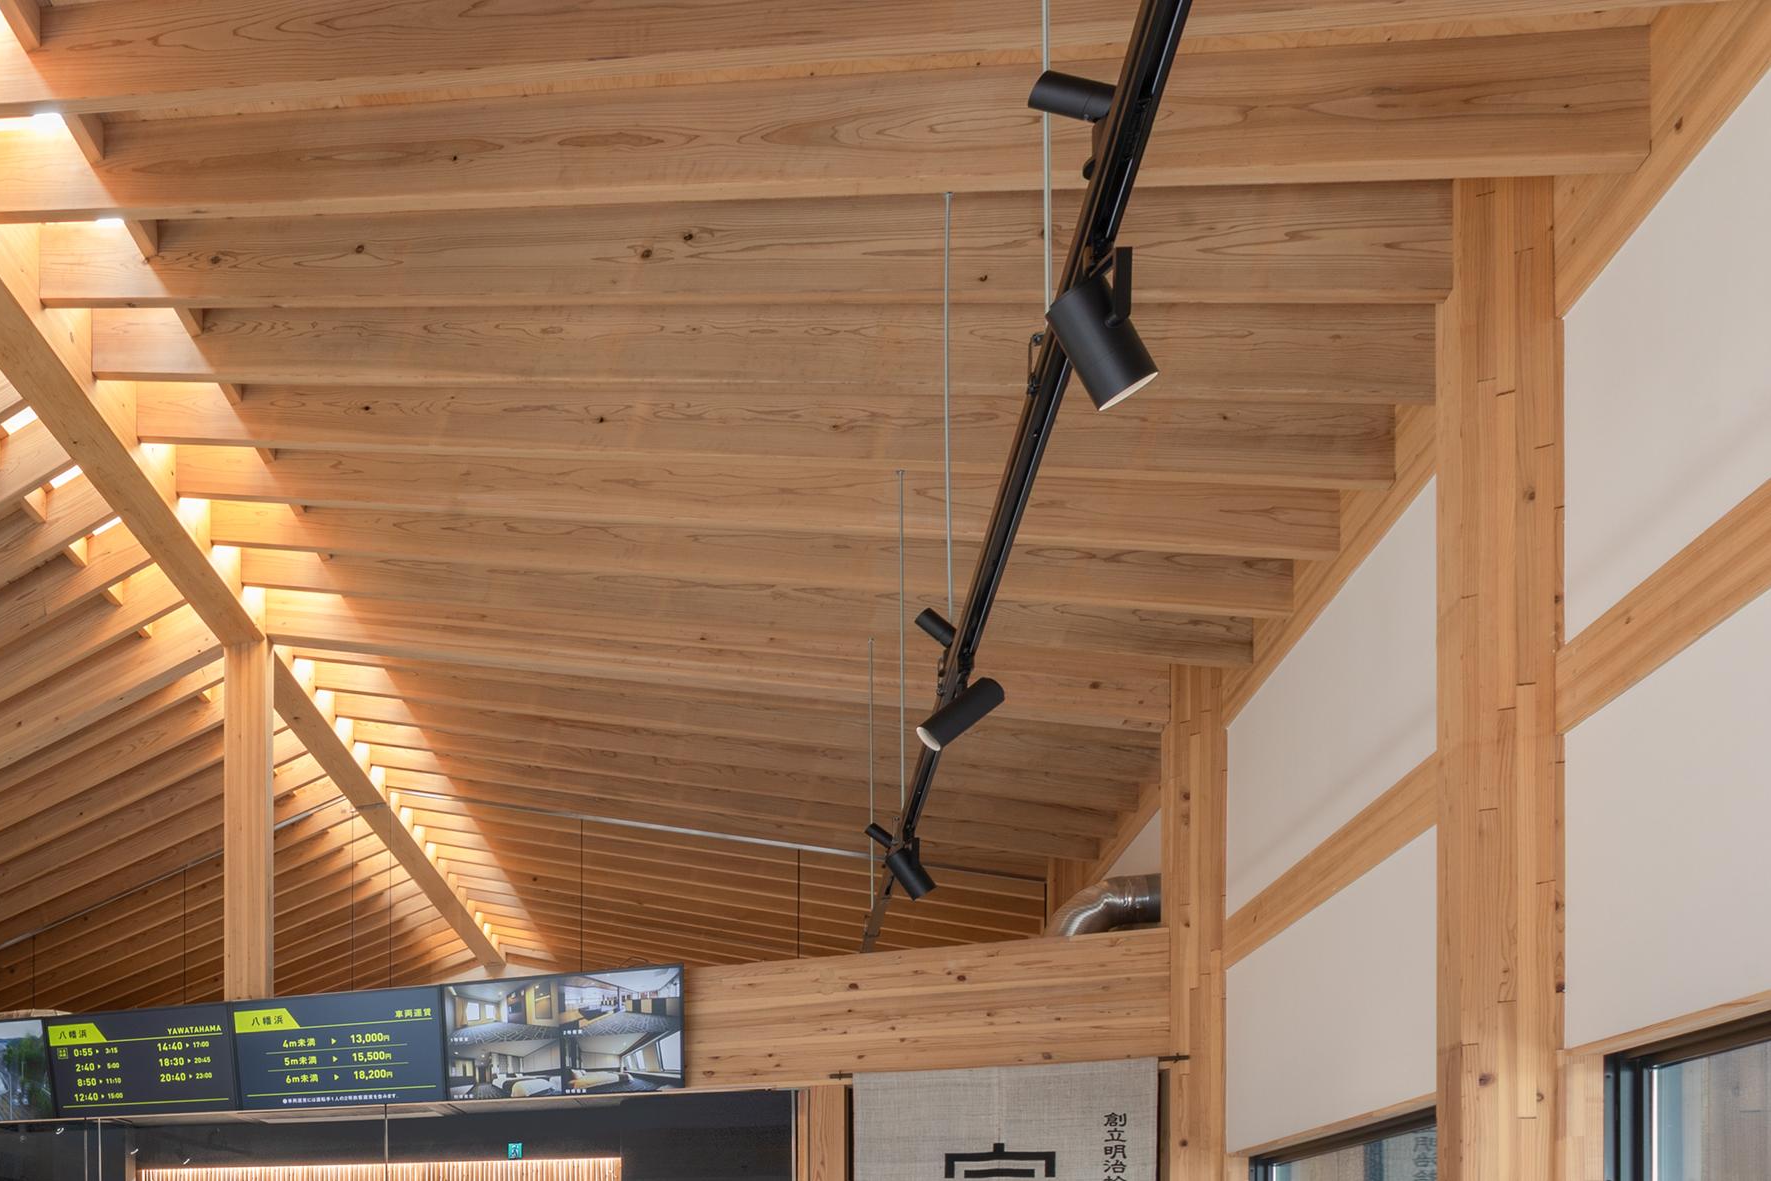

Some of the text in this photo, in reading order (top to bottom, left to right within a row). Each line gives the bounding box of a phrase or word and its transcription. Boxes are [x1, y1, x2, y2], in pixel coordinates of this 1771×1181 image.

[395, 1008, 432, 1019] 車両運賃
[251, 1015, 284, 1026] 八幡浜
[58, 1029, 88, 1040] 八幡浜
[167, 1025, 222, 1035] YAWATAHAMA
[282, 1033, 390, 1048] 4m未満 13,000円
[157, 1042, 183, 1051] 14:40
[73, 1048, 93, 1057] 0:55
[158, 1057, 185, 1067] 18:30
[284, 1051, 392, 1066] 5m未満 15,500円
[75, 1063, 95, 1072] 2:40
[160, 1073, 186, 1082] 20:40
[285, 1069, 393, 1084] 6m未満 18,200円
[77, 1078, 97, 1087] 8:50
[74, 1093, 99, 1102] 12:40
